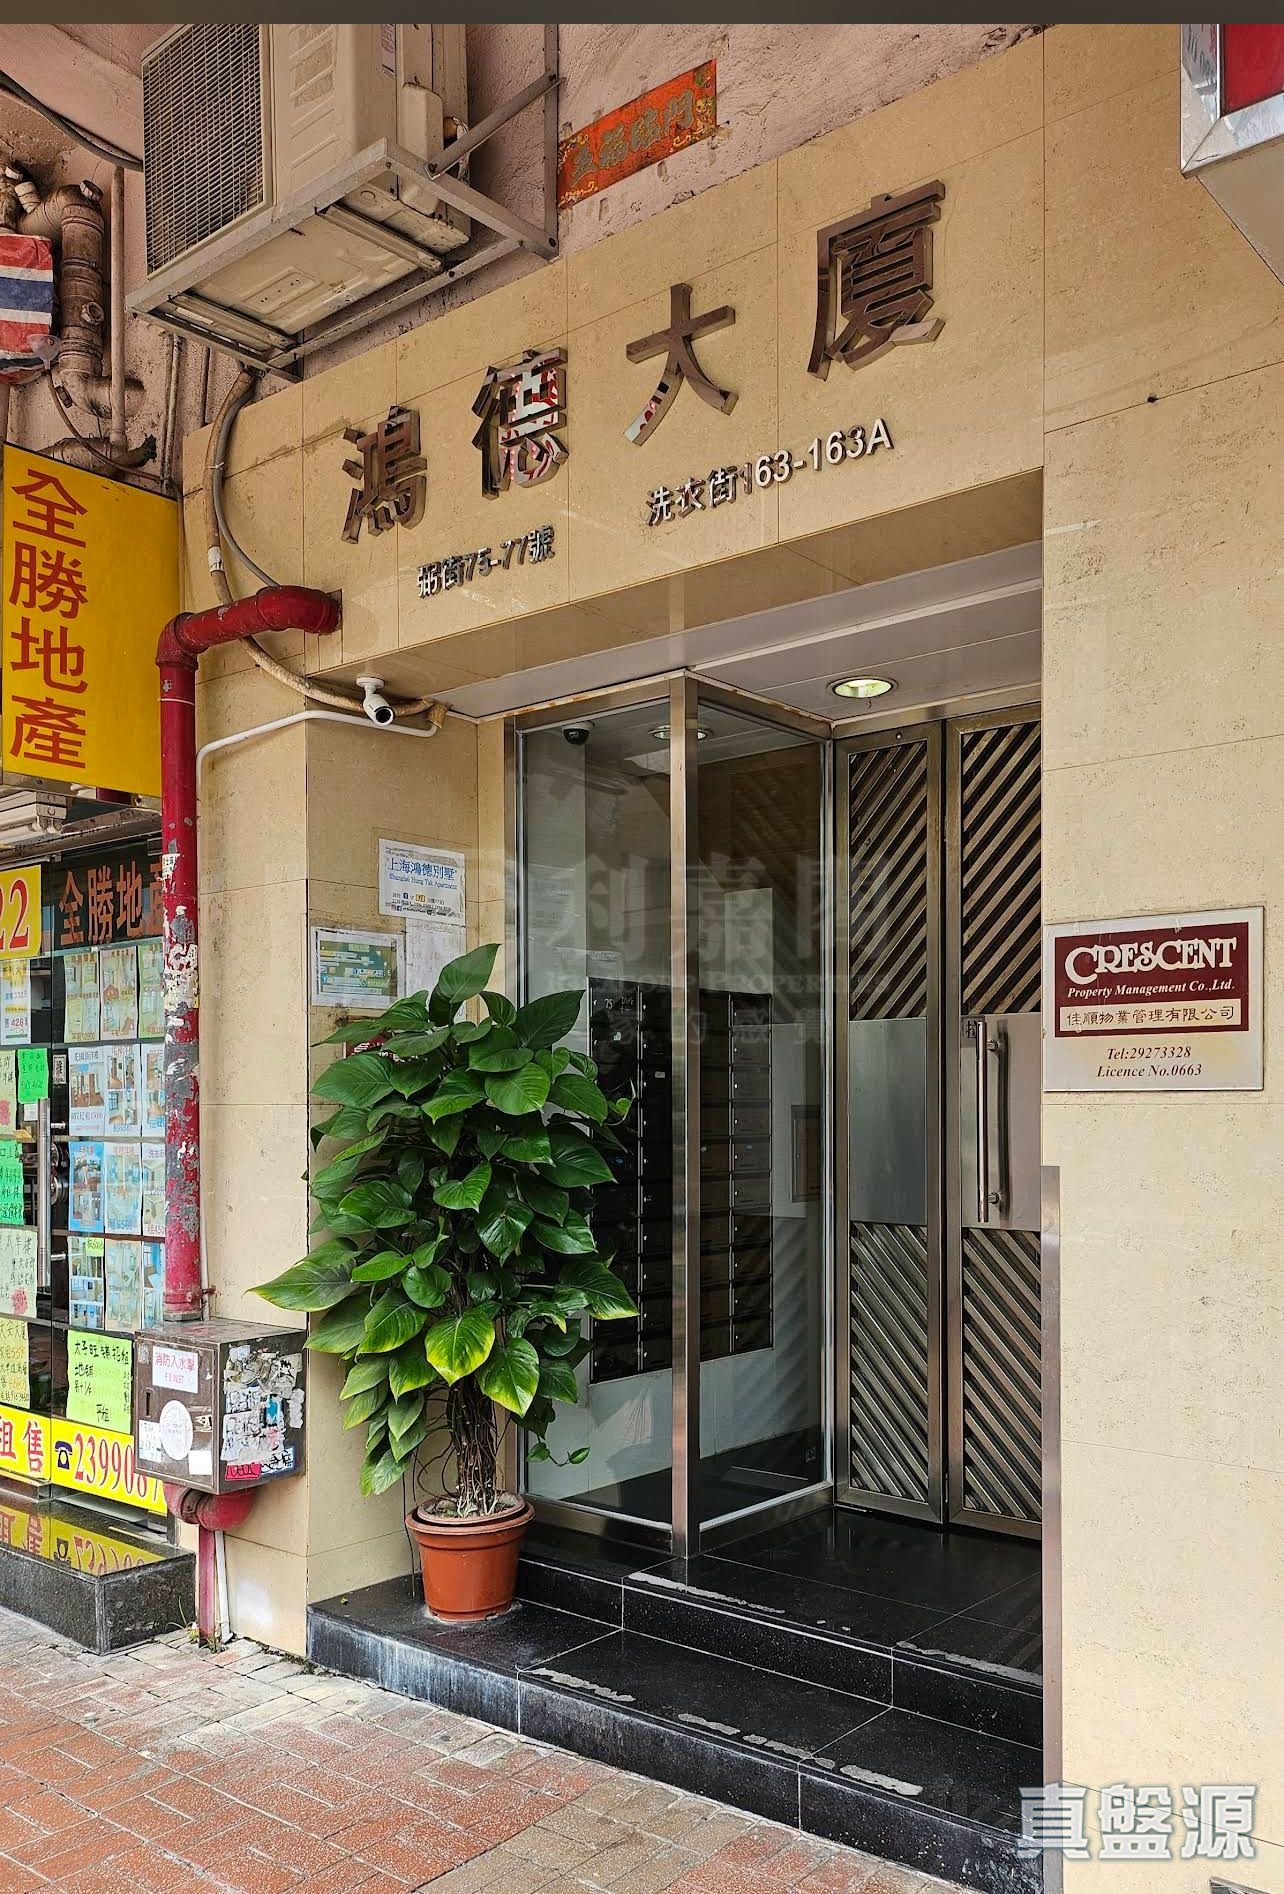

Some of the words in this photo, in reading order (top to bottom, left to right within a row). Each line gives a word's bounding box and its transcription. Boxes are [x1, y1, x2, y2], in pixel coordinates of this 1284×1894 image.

[645, 418, 895, 527] 洗衣街163-163A
[8, 468, 89, 769] 全勝地產
[1064, 936, 1237, 985] CRESCENT
[1067, 985, 1113, 999] Property
[1114, 982, 1187, 997] Management
[1066, 1004, 1236, 1027] 佳順物業管理有限公司
[1106, 1045, 1192, 1061] Tel:29273328
[1096, 1065, 1146, 1078] Licence
[1148, 1063, 1203, 1078] No.0663
